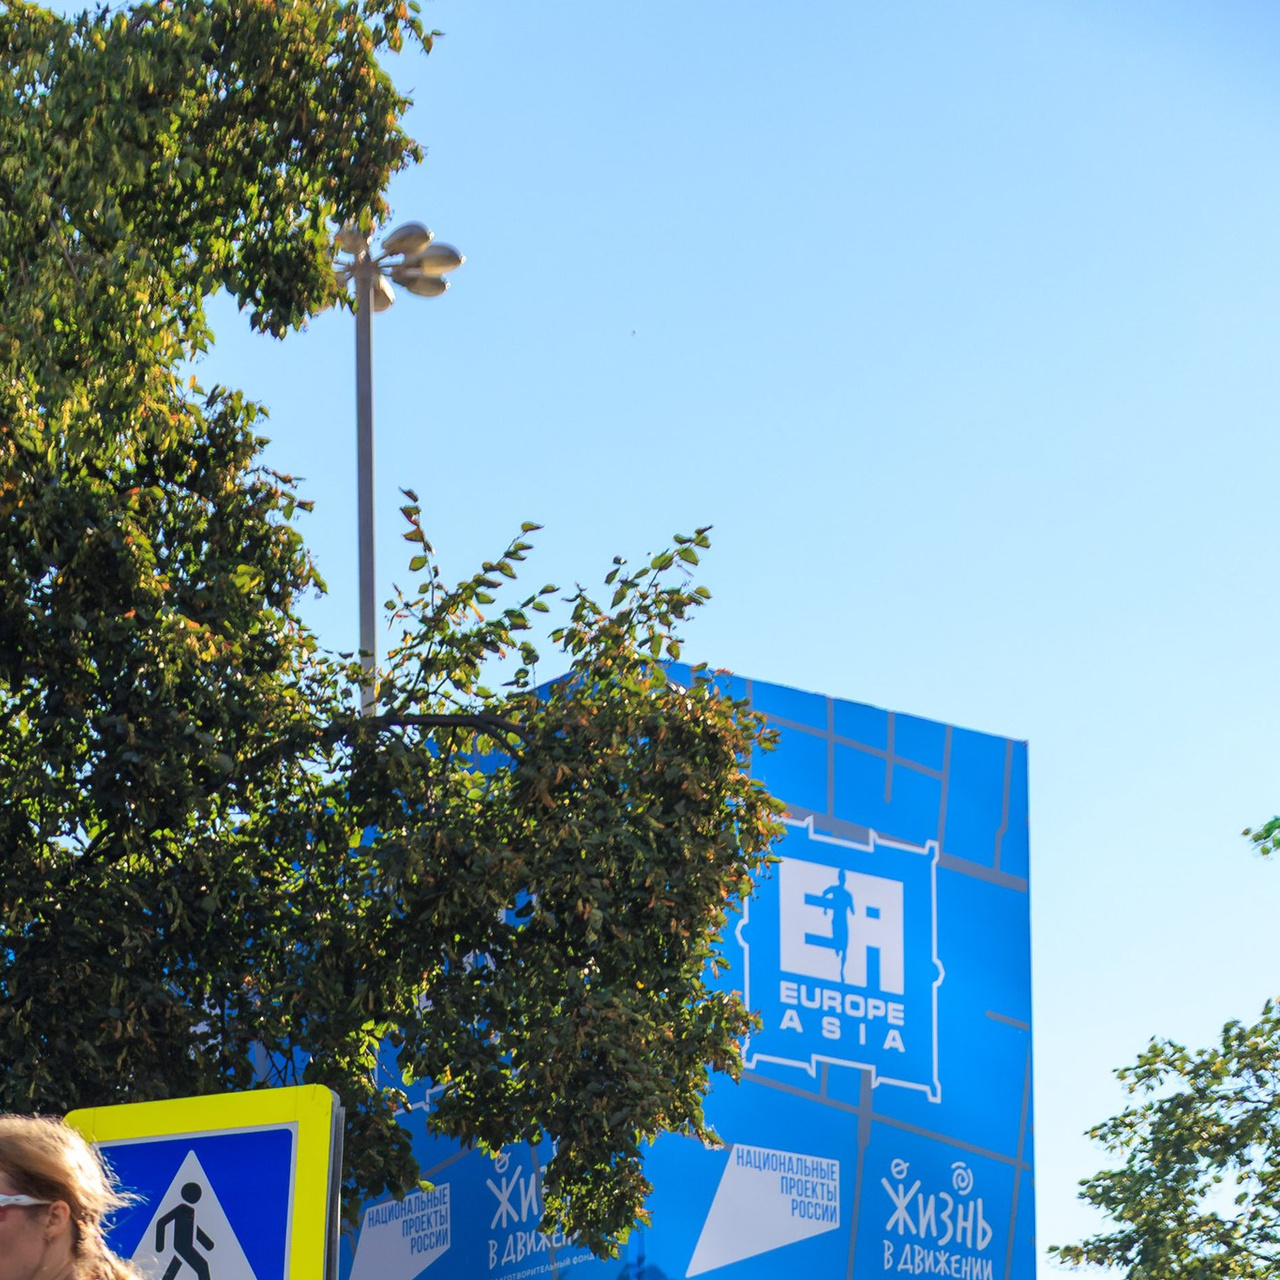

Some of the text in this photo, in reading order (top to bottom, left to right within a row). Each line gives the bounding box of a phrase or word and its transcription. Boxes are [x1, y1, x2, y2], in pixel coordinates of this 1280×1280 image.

[780, 980, 904, 1026] EUROPE
[780, 1009, 905, 1052] ASIA
[736, 1148, 837, 1181] НАЦИОНАЛЬНЫЕ
[781, 1176, 837, 1202] ПРОЕКТЫ
[368, 1189, 448, 1228] НАЦИОНАЛЬНЫЕ
[402, 1210, 448, 1238] ПРОЕКТЫ
[791, 1199, 837, 1224] РОССИИ
[881, 1176, 993, 1251] ЖИЗНЬ
[410, 1229, 449, 1255] РОССИИ
[489, 1239, 497, 1270] В
[883, 1240, 893, 1270] В
